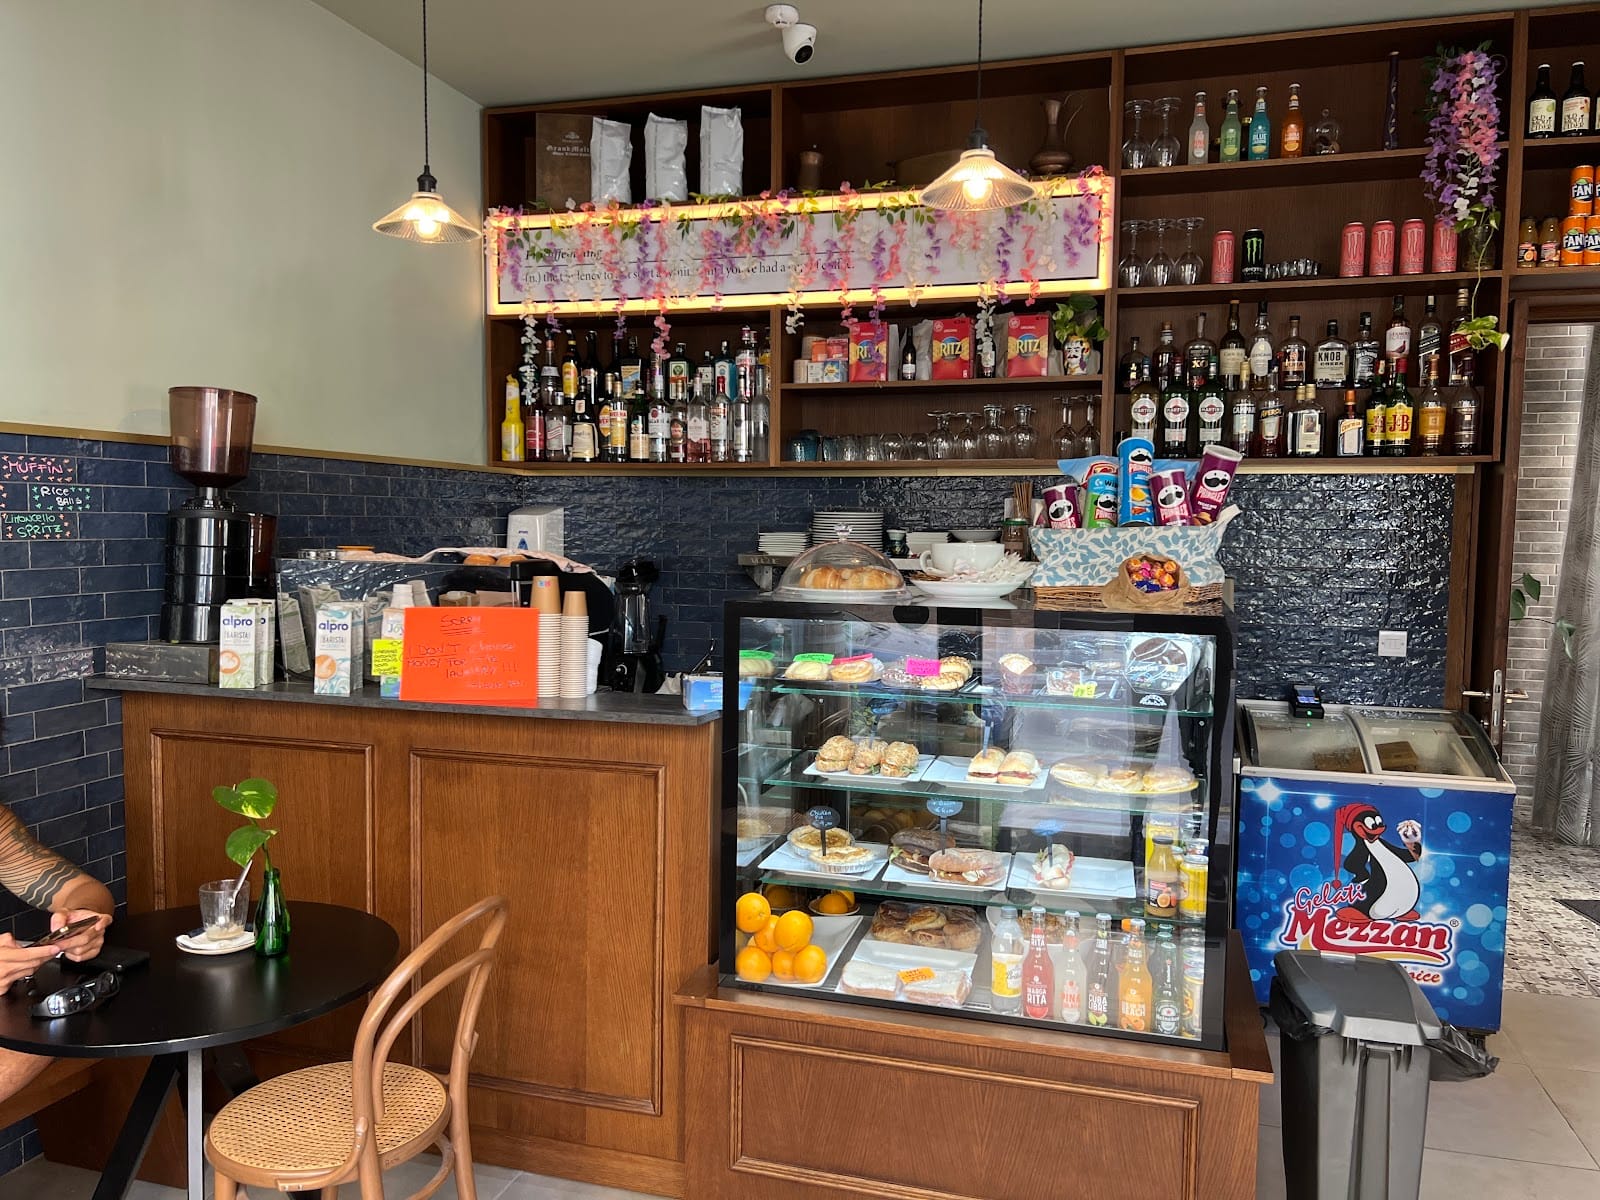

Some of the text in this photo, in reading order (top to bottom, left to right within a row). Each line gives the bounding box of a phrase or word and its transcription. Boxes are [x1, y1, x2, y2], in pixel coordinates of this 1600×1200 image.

[1572, 184, 1594, 198] FAN
[1563, 234, 1584, 248] FAN
[1584, 234, 1600, 248] FAN
[760, 260, 778, 272] had
[780, 264, 786, 272] a
[940, 342, 963, 356] RITZ
[1016, 339, 1040, 354] RITZ
[1318, 352, 1340, 362] KNOB
[1389, 414, 1410, 432] J&B
[222, 616, 252, 628] alpro
[318, 620, 349, 632] alpro
[1295, 883, 1367, 912] Gelati
[1284, 906, 1449, 951] Mezzan
[1026, 994, 1048, 1006] RITA
